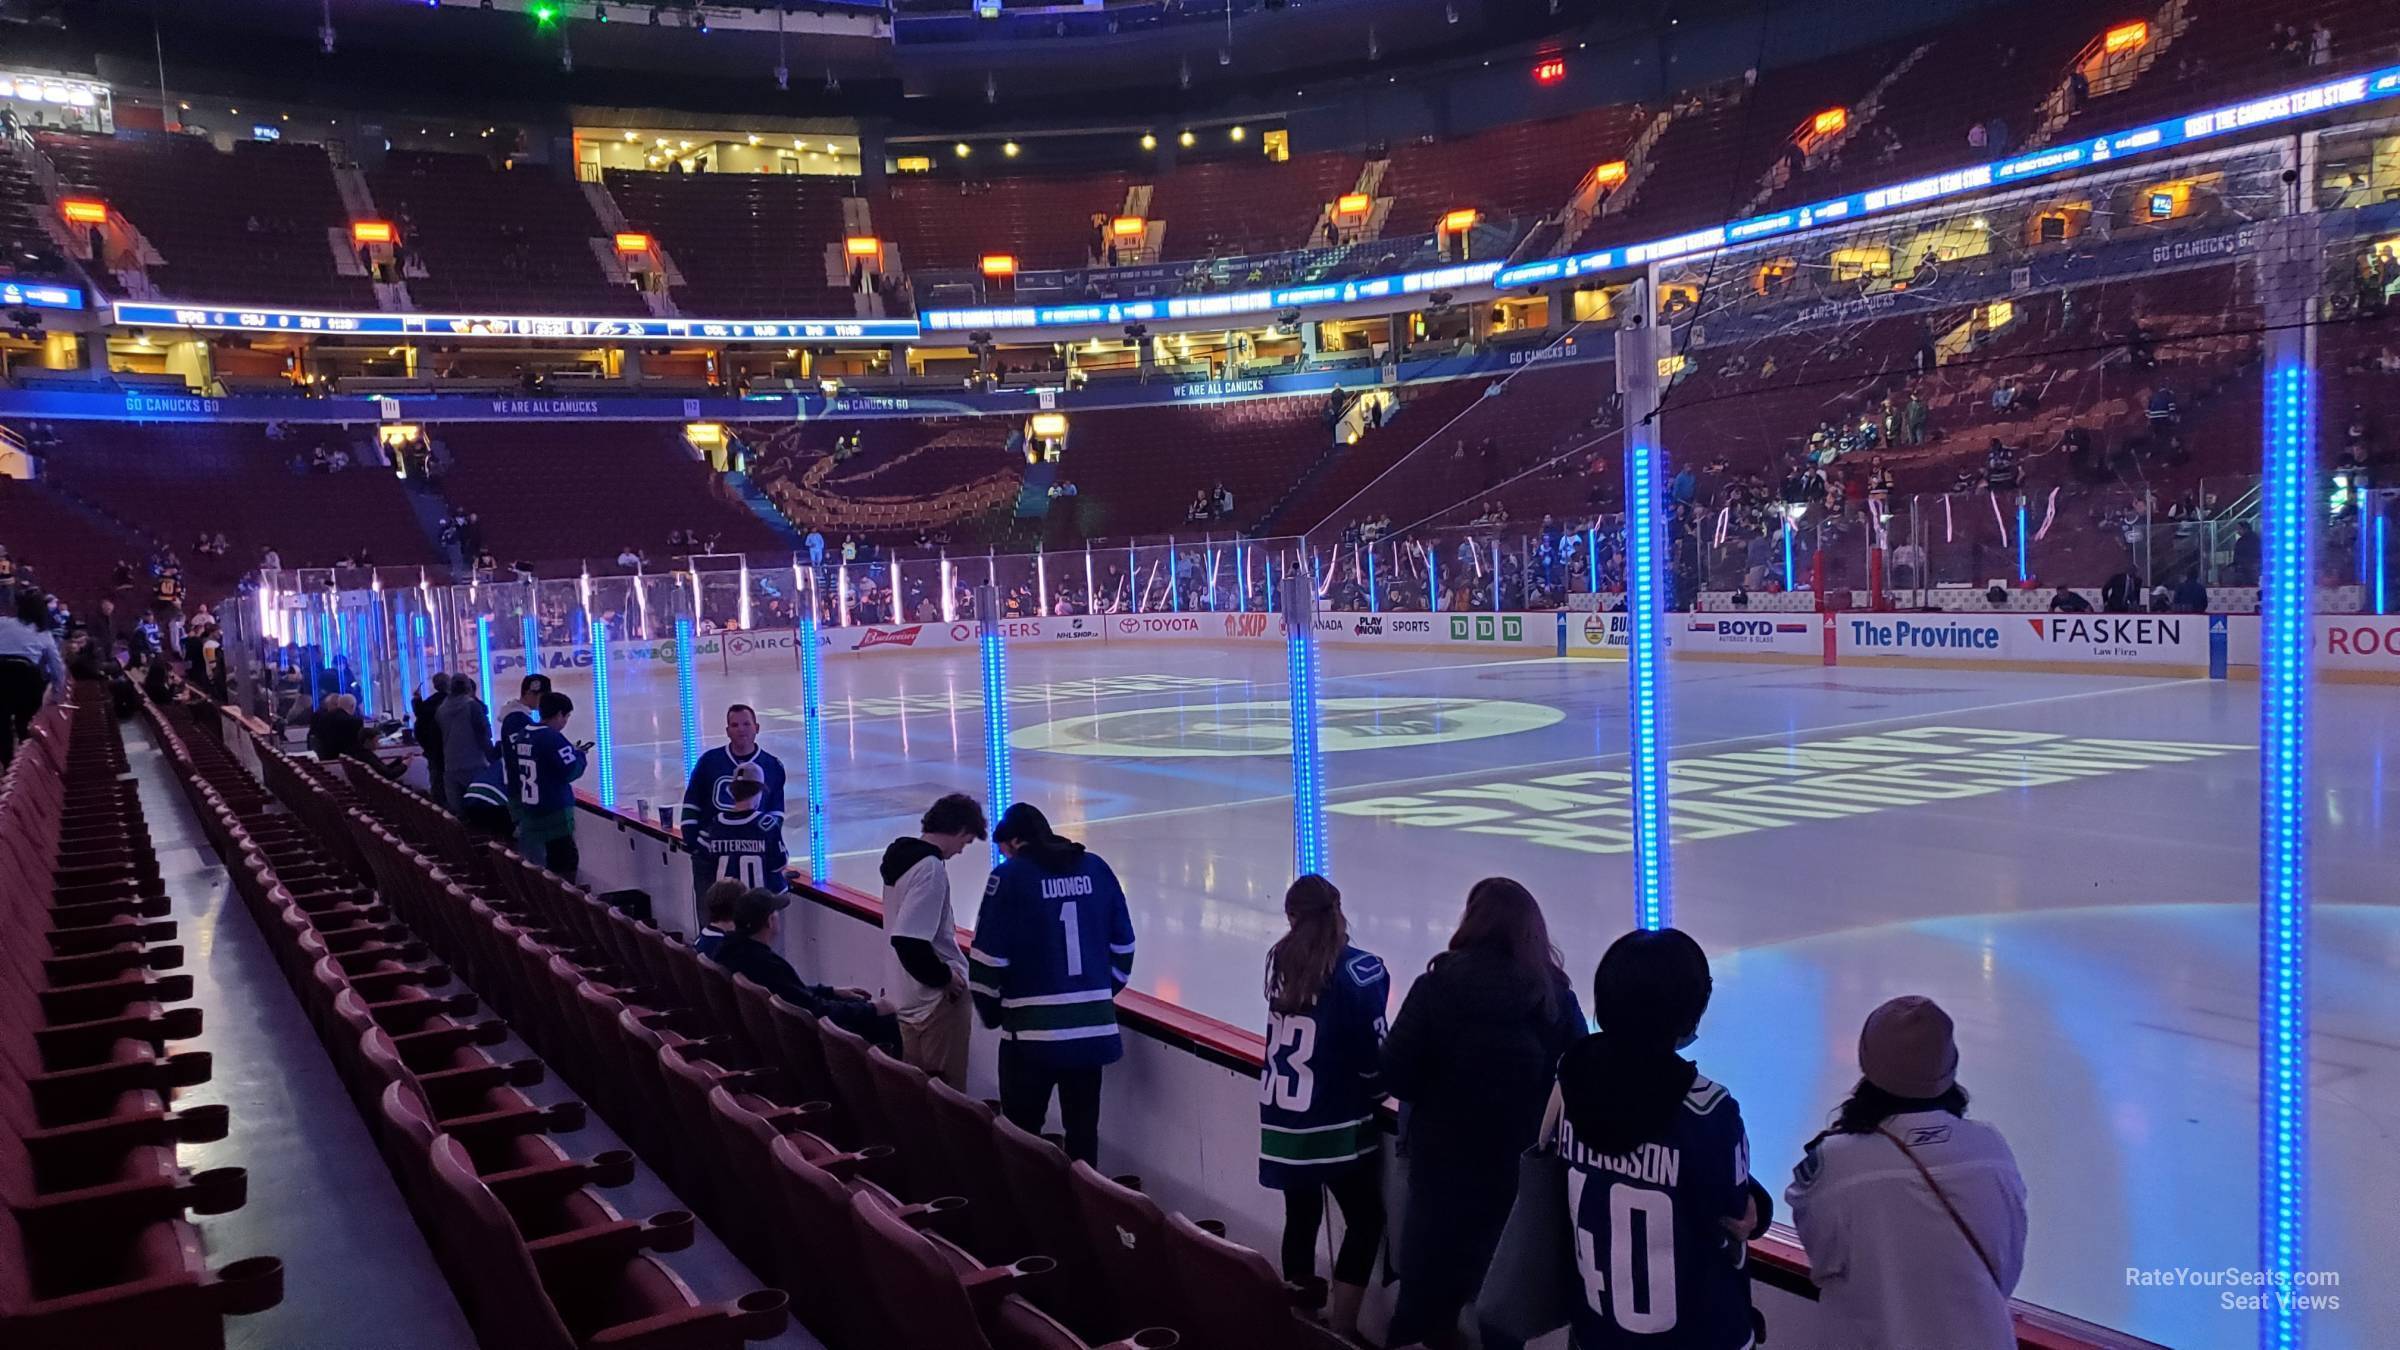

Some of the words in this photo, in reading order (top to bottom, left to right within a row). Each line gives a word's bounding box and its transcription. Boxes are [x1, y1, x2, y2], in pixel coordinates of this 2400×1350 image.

[2153, 246, 2170, 262] GO
[2174, 234, 2235, 259] CANUCKS
[1510, 352, 1522, 364] GO
[1173, 385, 1186, 397] WE
[1189, 383, 1205, 395] ARE
[1208, 382, 1223, 394] ALL
[1225, 379, 1264, 394] CANUCKS
[126, 398, 142, 411] GO
[146, 398, 200, 412] CANUCKS
[204, 400, 219, 412] GO
[493, 401, 509, 413] WE
[512, 401, 530, 413] ARE
[533, 401, 549, 413] ALL
[553, 401, 598, 413] CANUCKS
[837, 400, 850, 411] GO
[852, 399, 893, 410] CANUCKS
[896, 399, 909, 410] GO
[1143, 618, 1199, 632] TOYOTA
[1238, 614, 1267, 637] SKIP
[1313, 620, 1343, 632] ANADA
[1359, 616, 1382, 626] PLAY
[1392, 620, 1430, 633] SPORTS
[1452, 620, 1466, 636] TD
[1477, 620, 1493, 636] TD
[1503, 620, 1520, 637] TD
[1718, 620, 1773, 636] BOYD
[865, 628, 918, 645] Budweiser
[974, 623, 1041, 640] RGERS
[1359, 625, 1383, 635] NOW
[1852, 620, 1892, 647] The
[1896, 620, 1999, 649] Province
[2052, 618, 2180, 645] FASKEN
[754, 639, 777, 650] AIR
[2094, 648, 2112, 656] Law
[1041, 875, 1093, 899] LUONGO
[1059, 901, 1083, 976] 1
[1259, 1010, 1317, 1113] 33
[1567, 1166, 1678, 1334] 40
